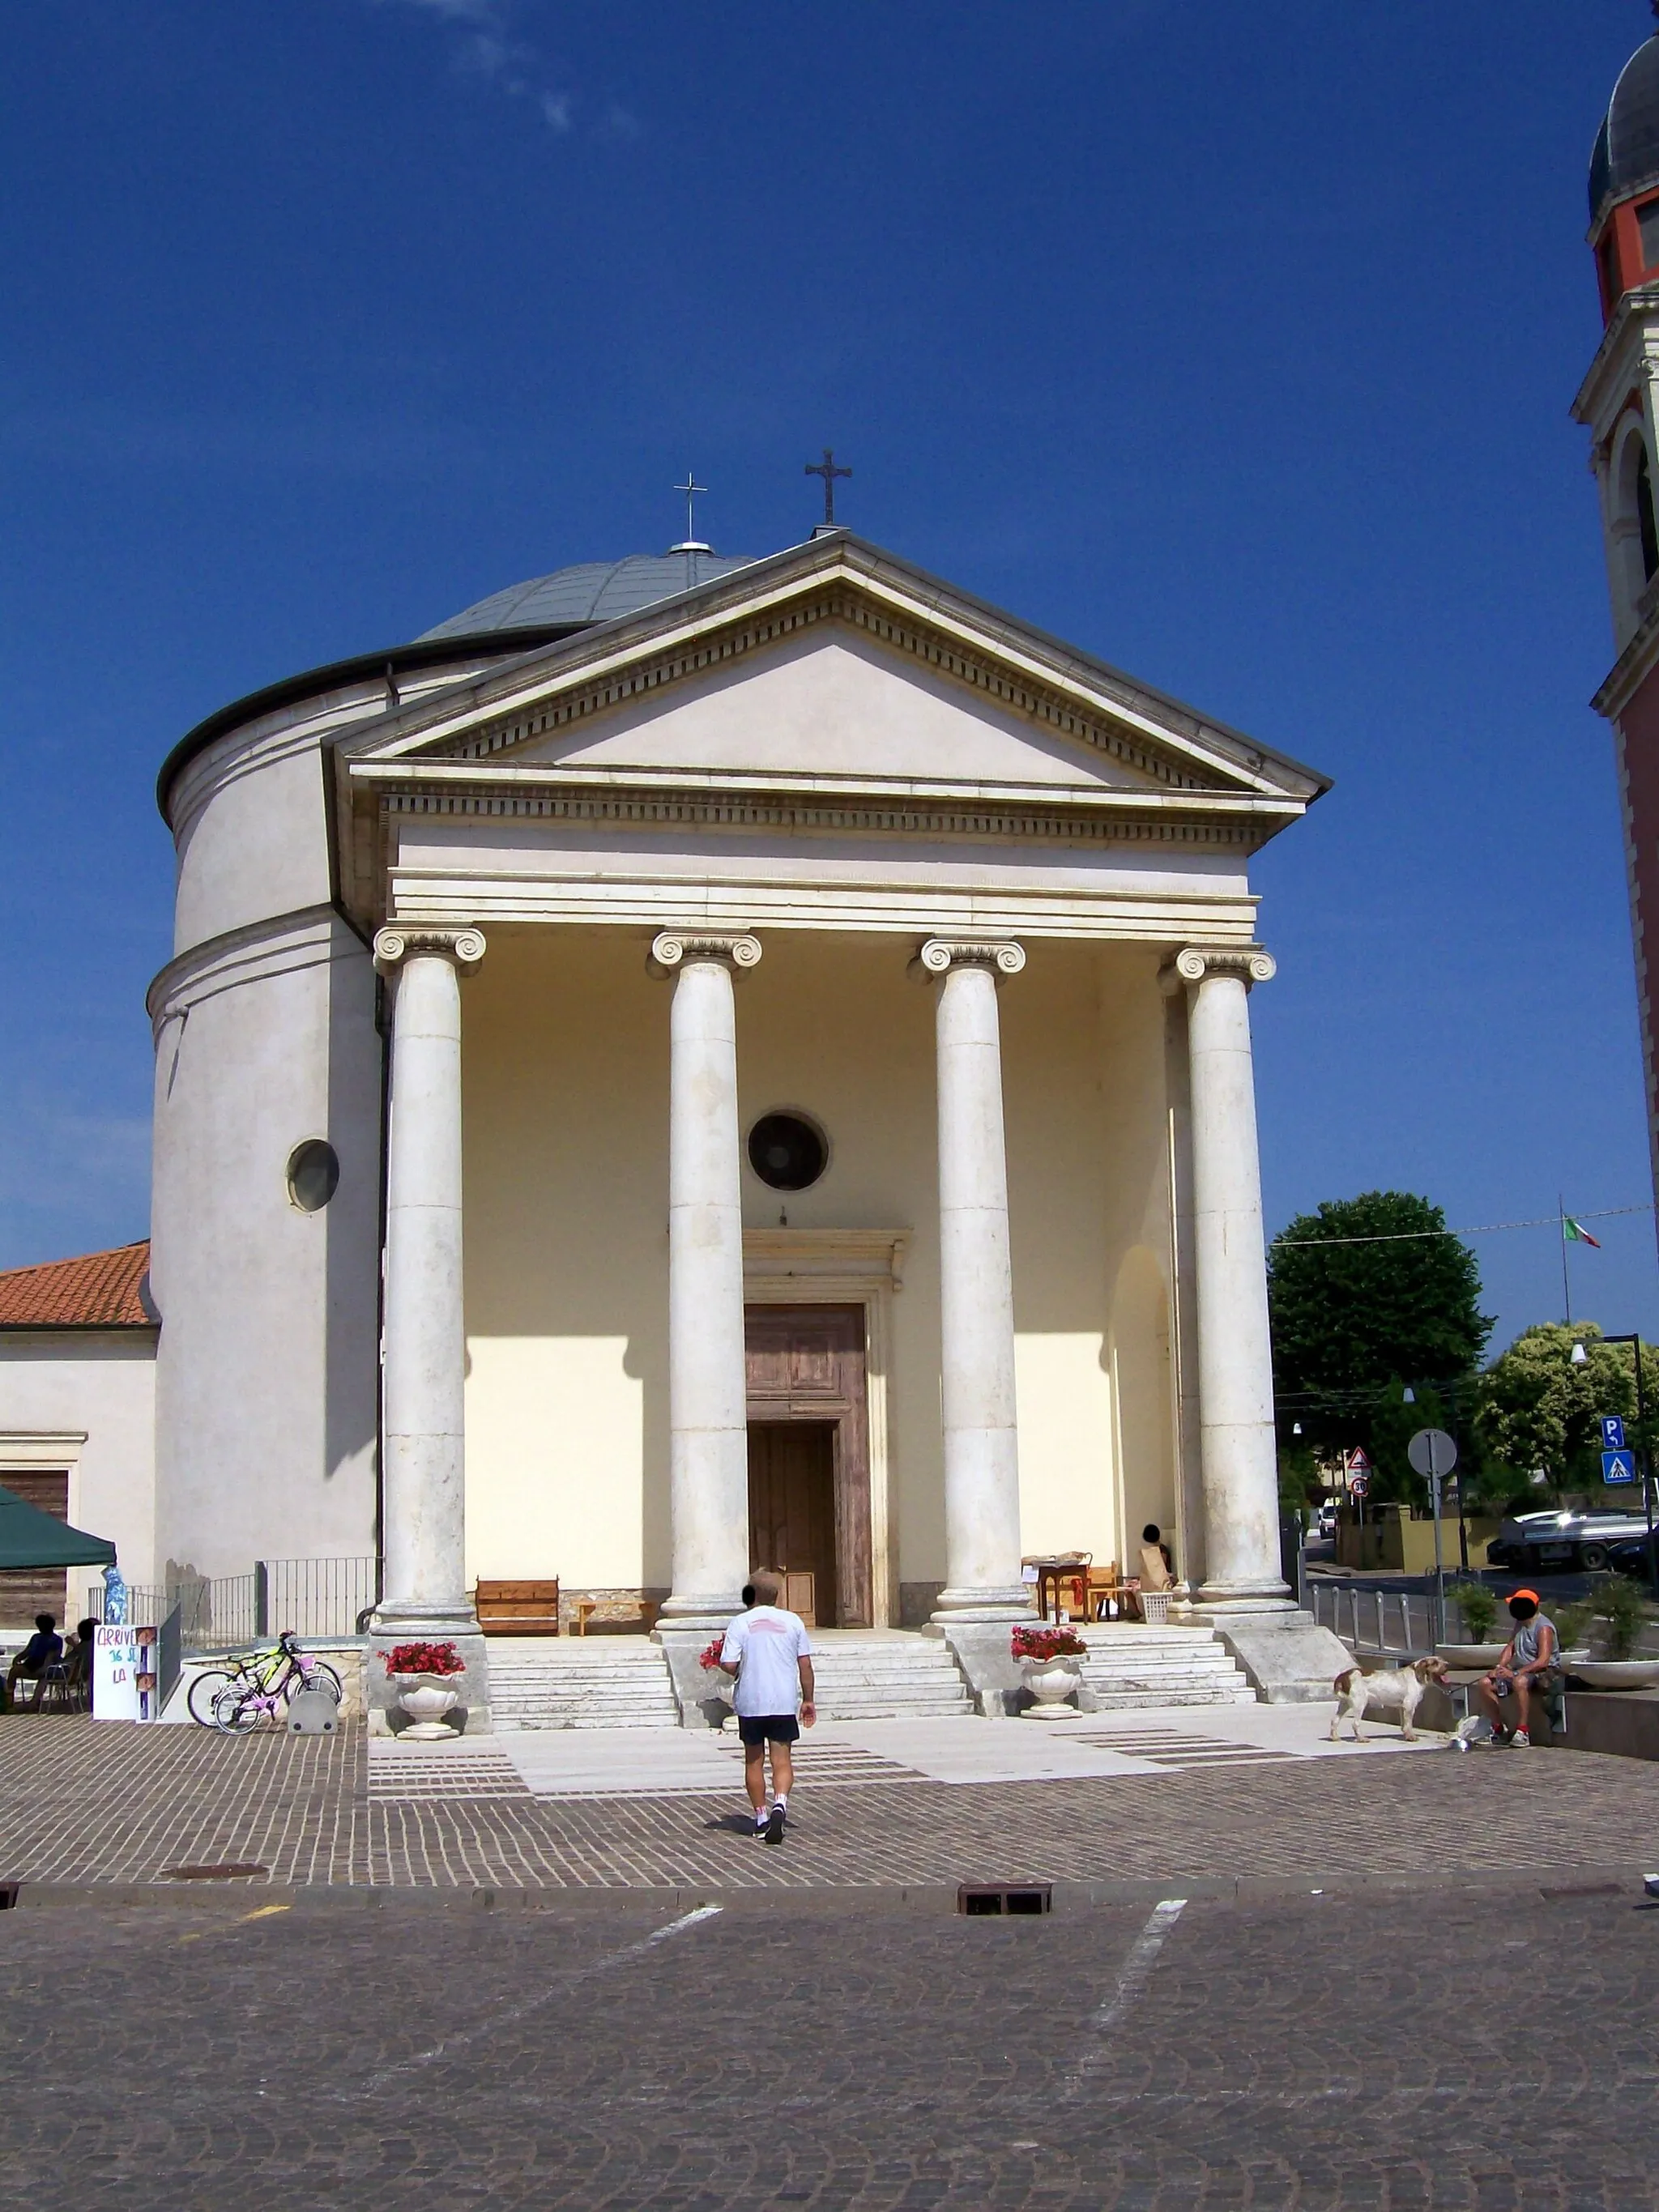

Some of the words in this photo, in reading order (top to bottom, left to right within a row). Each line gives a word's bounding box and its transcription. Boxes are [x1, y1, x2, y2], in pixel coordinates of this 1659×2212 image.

[1606, 1420, 1618, 1434] P
[1355, 1482, 1365, 1491] 30
[113, 1669, 126, 1684] LA
